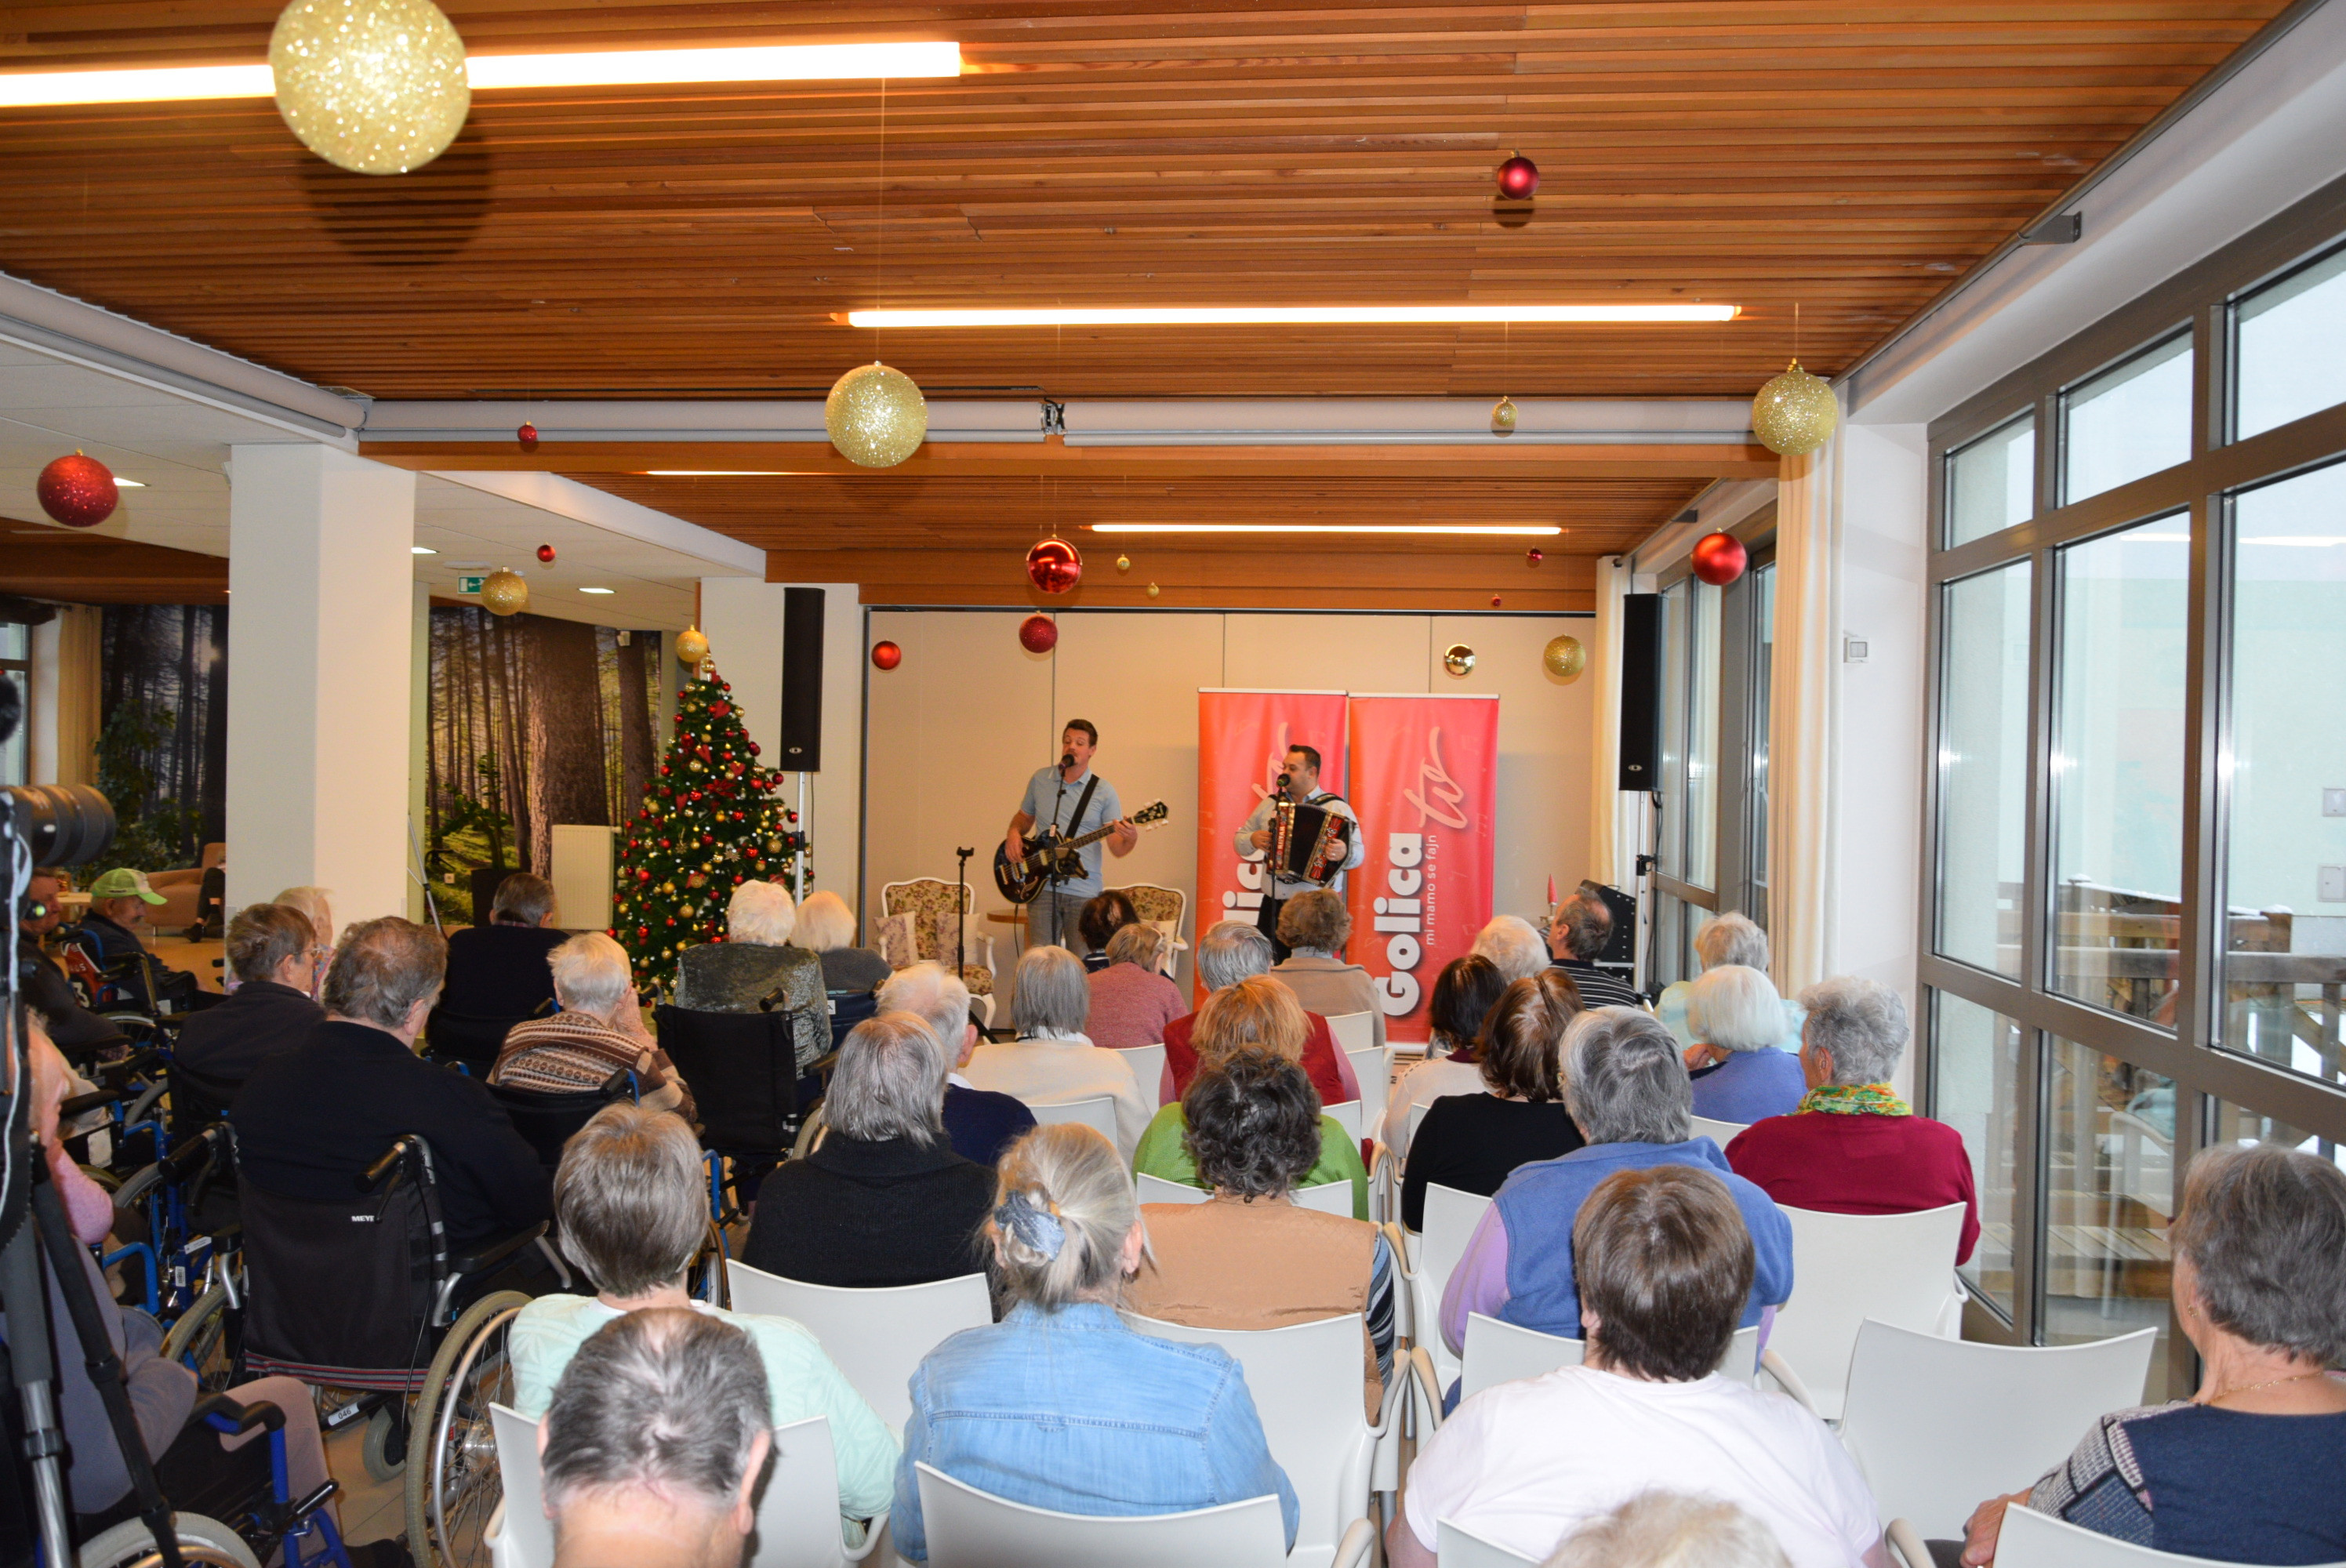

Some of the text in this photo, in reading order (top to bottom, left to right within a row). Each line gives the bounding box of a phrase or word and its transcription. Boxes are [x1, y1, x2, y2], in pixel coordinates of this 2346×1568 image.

[1373, 726, 1468, 1016] Golica tv
[1424, 834, 1440, 946] mi mamo se fajn
[338, 1407, 352, 1420] 046
